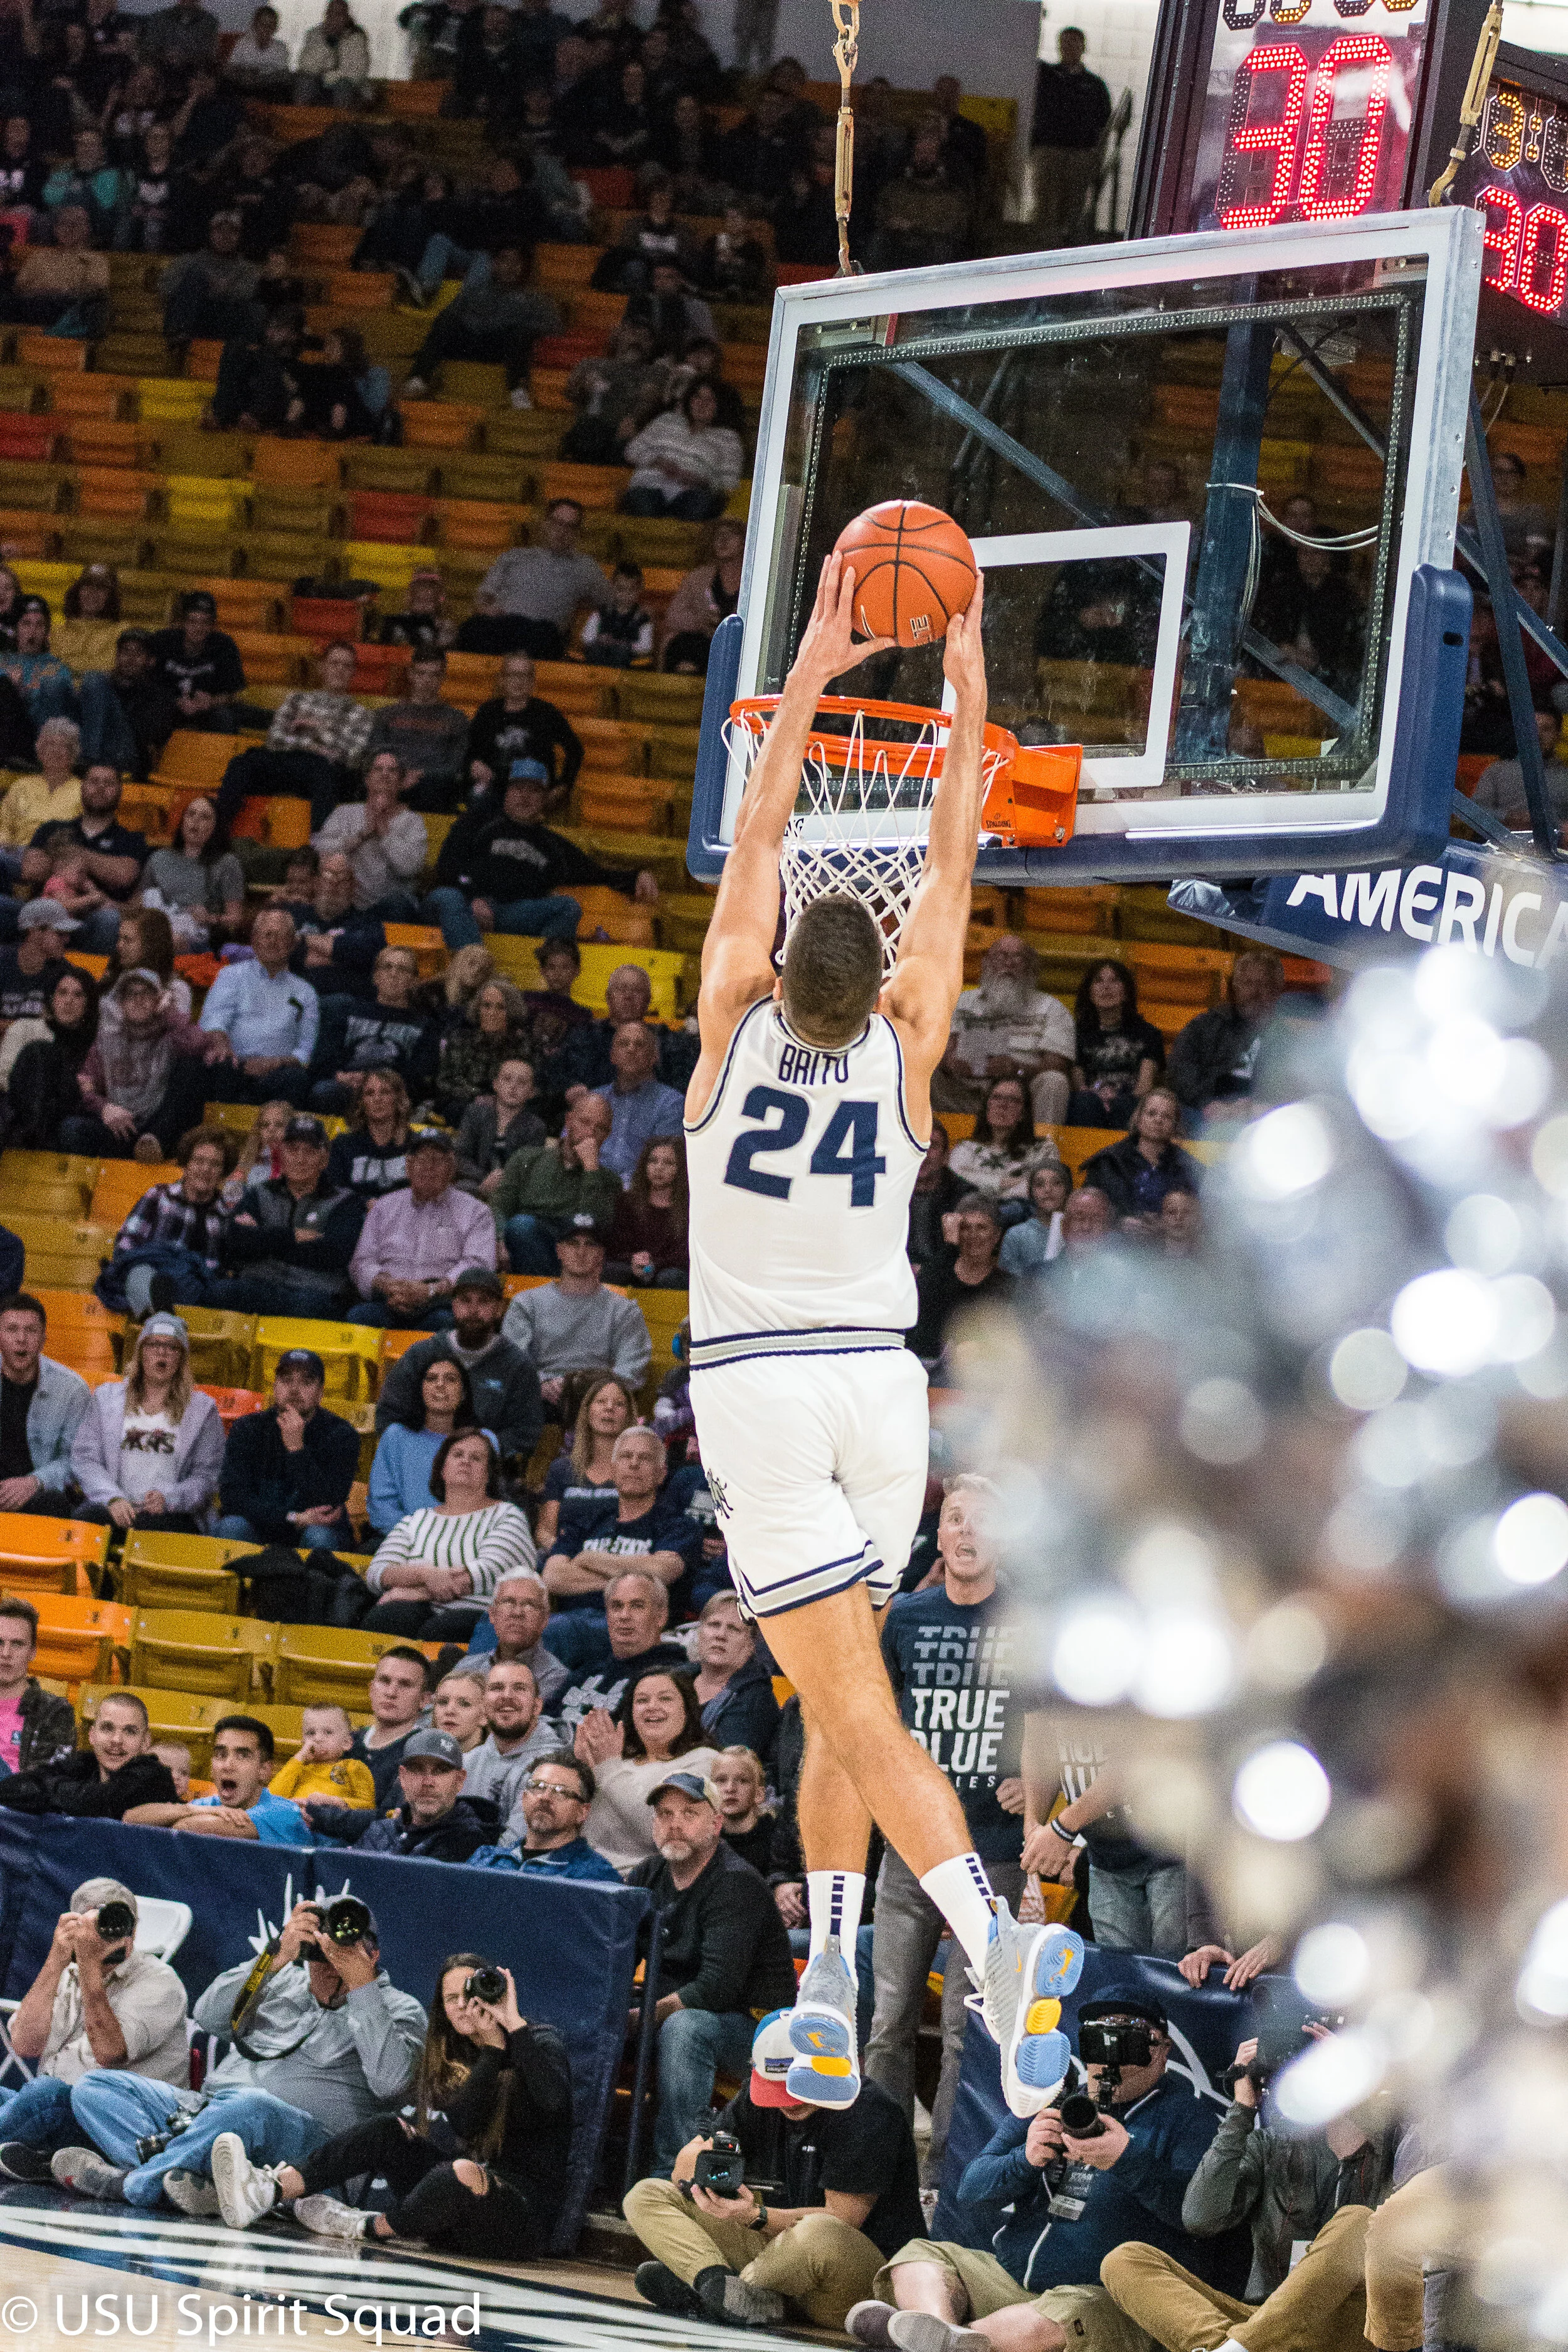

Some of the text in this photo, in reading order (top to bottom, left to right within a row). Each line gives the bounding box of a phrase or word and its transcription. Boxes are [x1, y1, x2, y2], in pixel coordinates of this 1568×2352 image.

[1221, 34, 1392, 230] 30
[723, 1084, 886, 1207] 24
[910, 1688, 1010, 1731] TRUE
